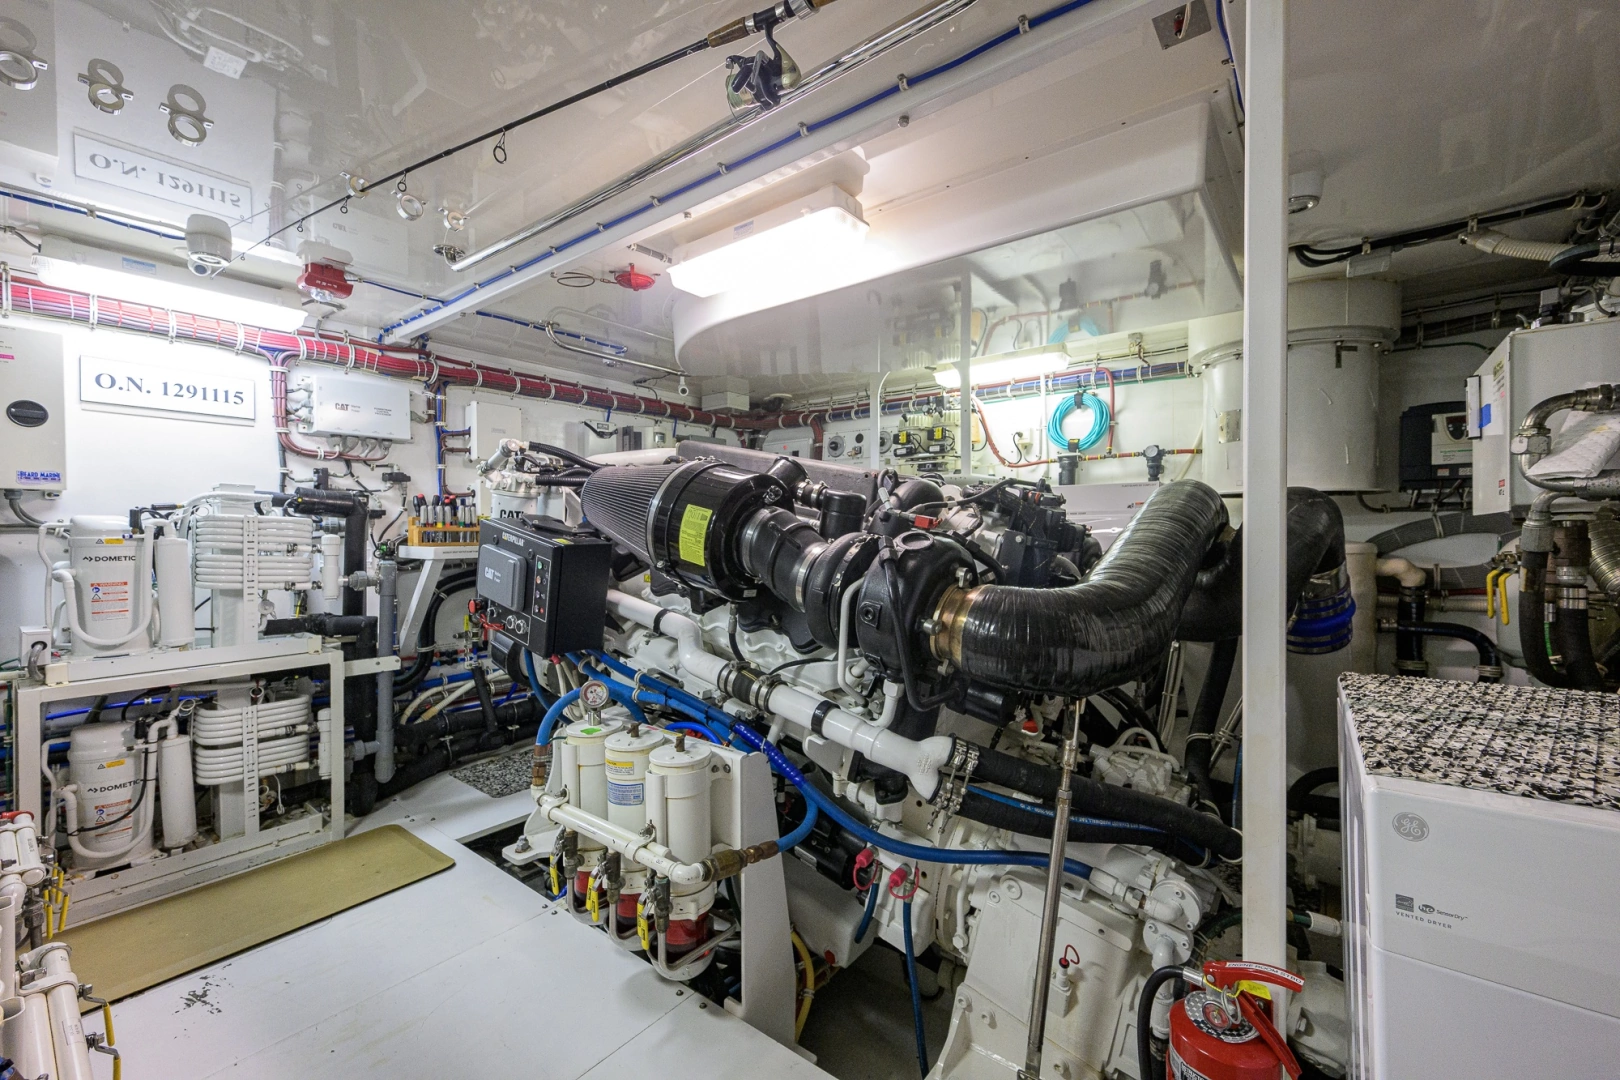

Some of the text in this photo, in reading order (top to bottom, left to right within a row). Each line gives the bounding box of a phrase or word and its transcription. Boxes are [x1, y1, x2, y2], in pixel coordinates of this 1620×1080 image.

[95, 373, 245, 405] O.N. 1291115
[335, 403, 349, 411] CAT
[485, 567, 495, 580] CAT
[100, 779, 140, 792] DOMETIC
[1396, 911, 1452, 929] VENTED DRYER
